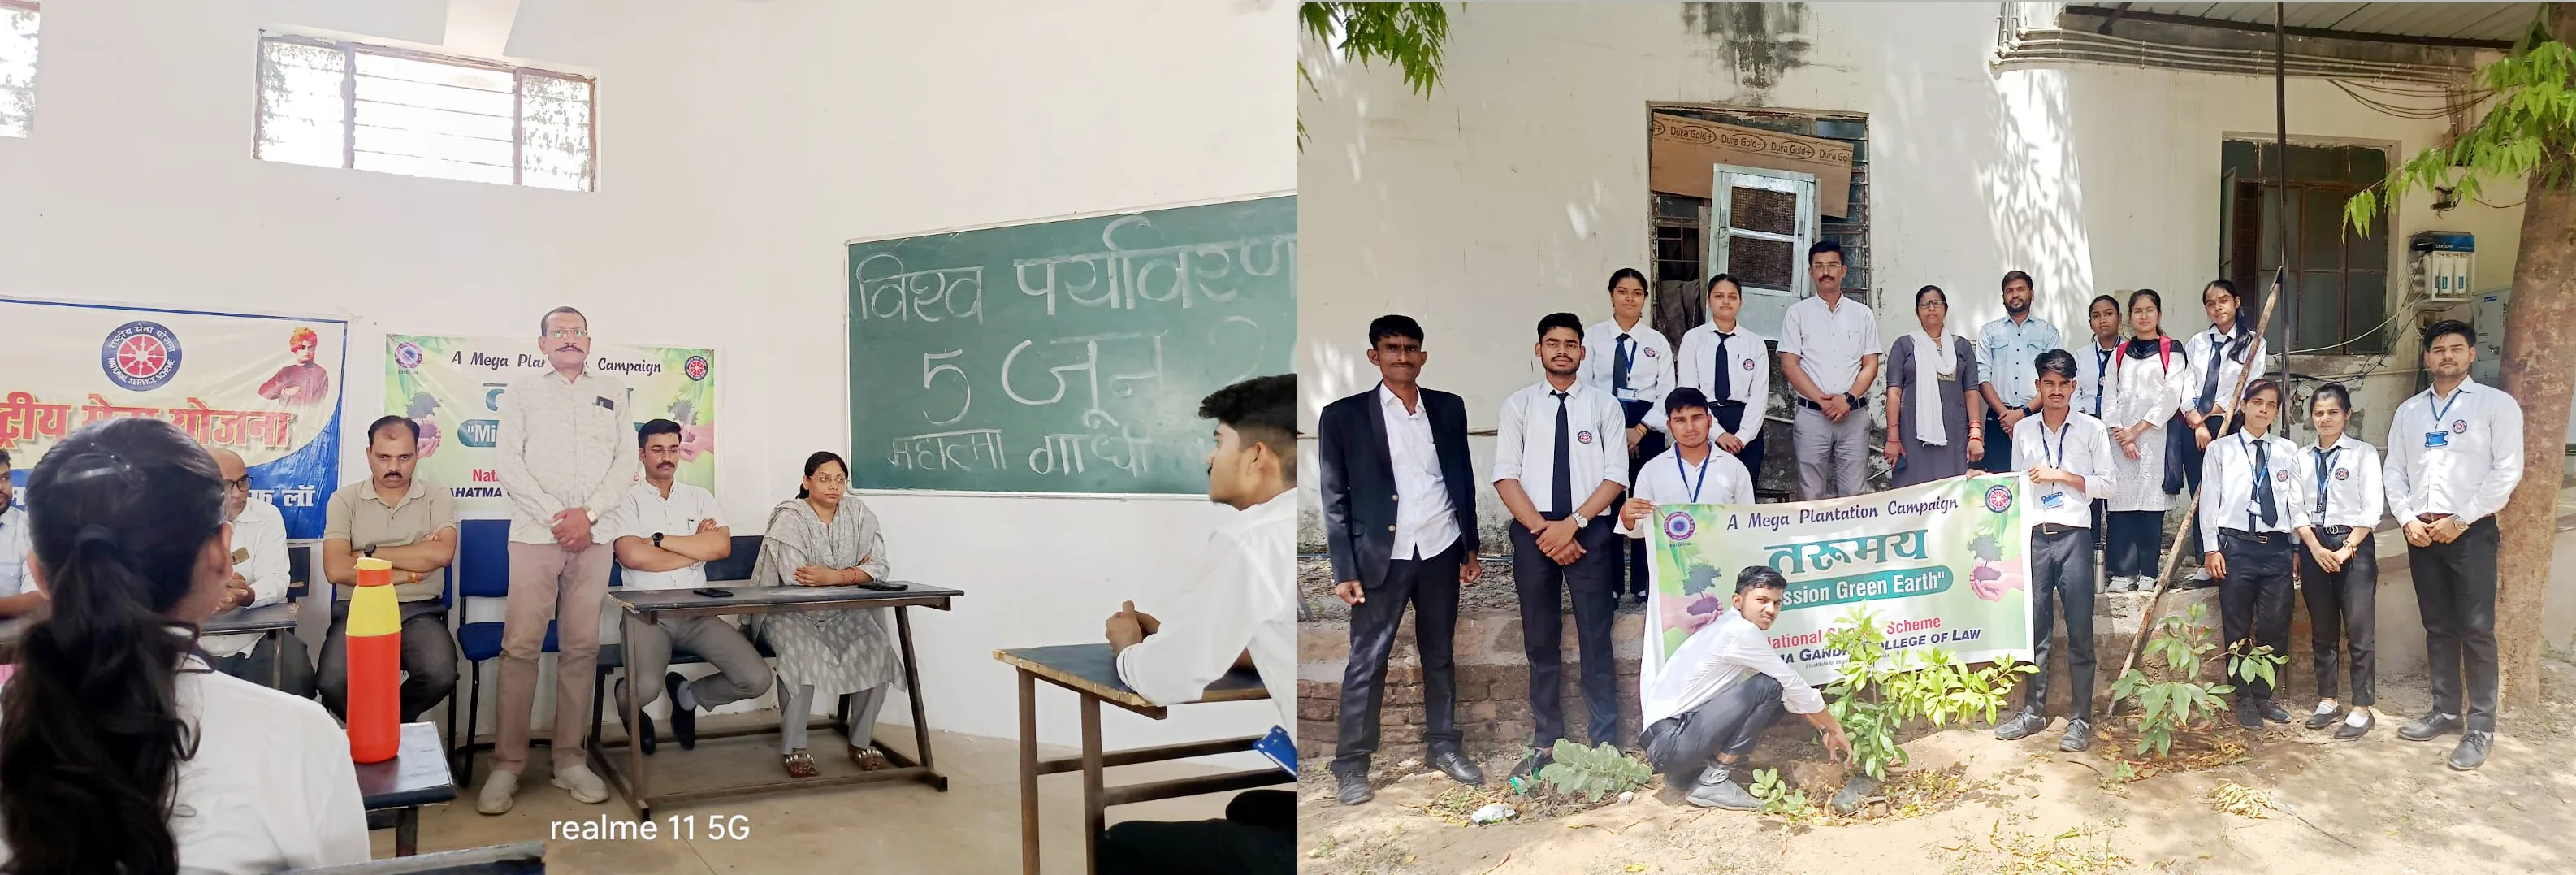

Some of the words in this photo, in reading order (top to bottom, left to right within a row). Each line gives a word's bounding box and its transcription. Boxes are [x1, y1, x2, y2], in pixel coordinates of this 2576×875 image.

[1670, 126, 1689, 137] Dura
[1721, 134, 1738, 145] Dura
[1771, 141, 1787, 153] Dura
[1819, 149, 1836, 160] Dura
[855, 253, 984, 323] विश्व
[1012, 215, 1297, 316] पर्यावरण
[134, 323, 154, 334] सेवा
[156, 330, 175, 353] योजना
[107, 357, 128, 383] NATIONAL
[128, 376, 158, 386] SERVICE
[155, 358, 175, 380] SCHEME
[452, 350, 462, 365] A
[470, 352, 509, 370] Mega
[597, 357, 662, 376] Campaign
[922, 349, 971, 426] 5
[1001, 330, 1170, 428] जून
[451, 487, 503, 498] HATMA
[1727, 514, 1738, 531] A
[1748, 512, 1790, 531] Mega
[1799, 504, 1878, 525] Plantation
[1887, 496, 1959, 516] Campaign
[1836, 579, 1888, 600] Green
[1894, 571, 1945, 593] Earth"
[1886, 617, 1942, 635] Scheme
[1930, 632, 1949, 643] OF
[1952, 629, 1981, 641] LAW
